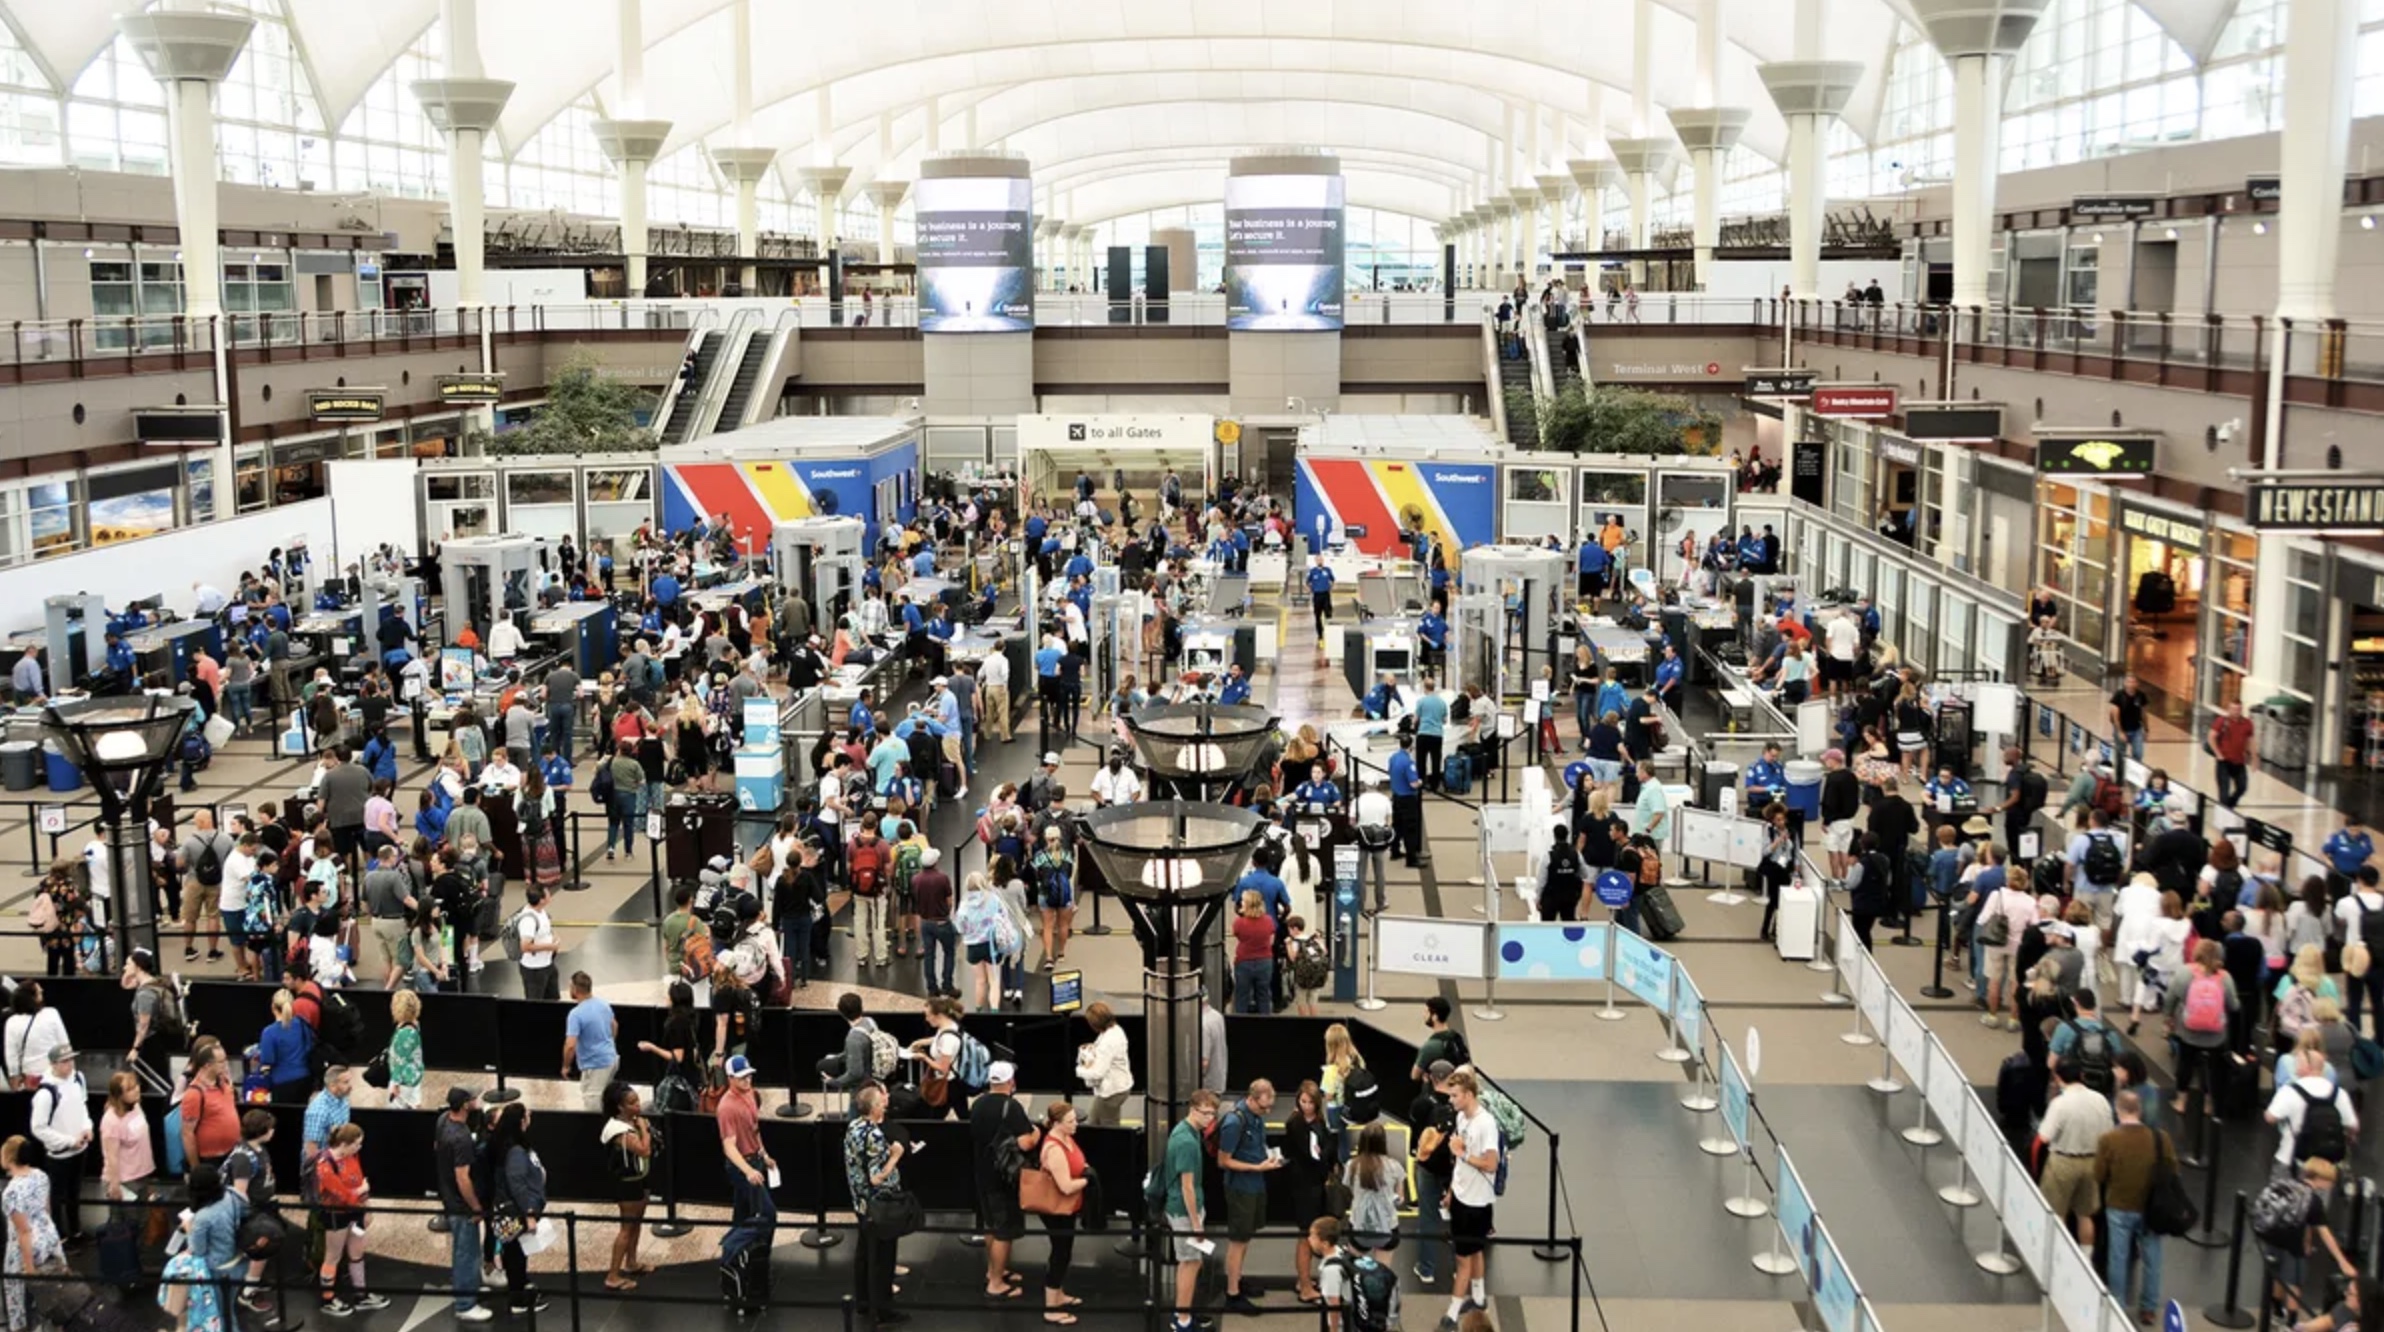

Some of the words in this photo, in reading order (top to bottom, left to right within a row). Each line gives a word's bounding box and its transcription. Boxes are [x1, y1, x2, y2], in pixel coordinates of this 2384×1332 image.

[1613, 363, 1668, 375] Terminal
[1670, 363, 1703, 375] West
[1091, 427, 1105, 438] to
[1107, 426, 1123, 438] all
[1126, 426, 1162, 438] Gates
[811, 468, 857, 480] Southwest
[1435, 472, 1480, 484] Southwest
[2260, 488, 2384, 523] NEWSSTAND
[1412, 952, 1450, 963] CLEAR
